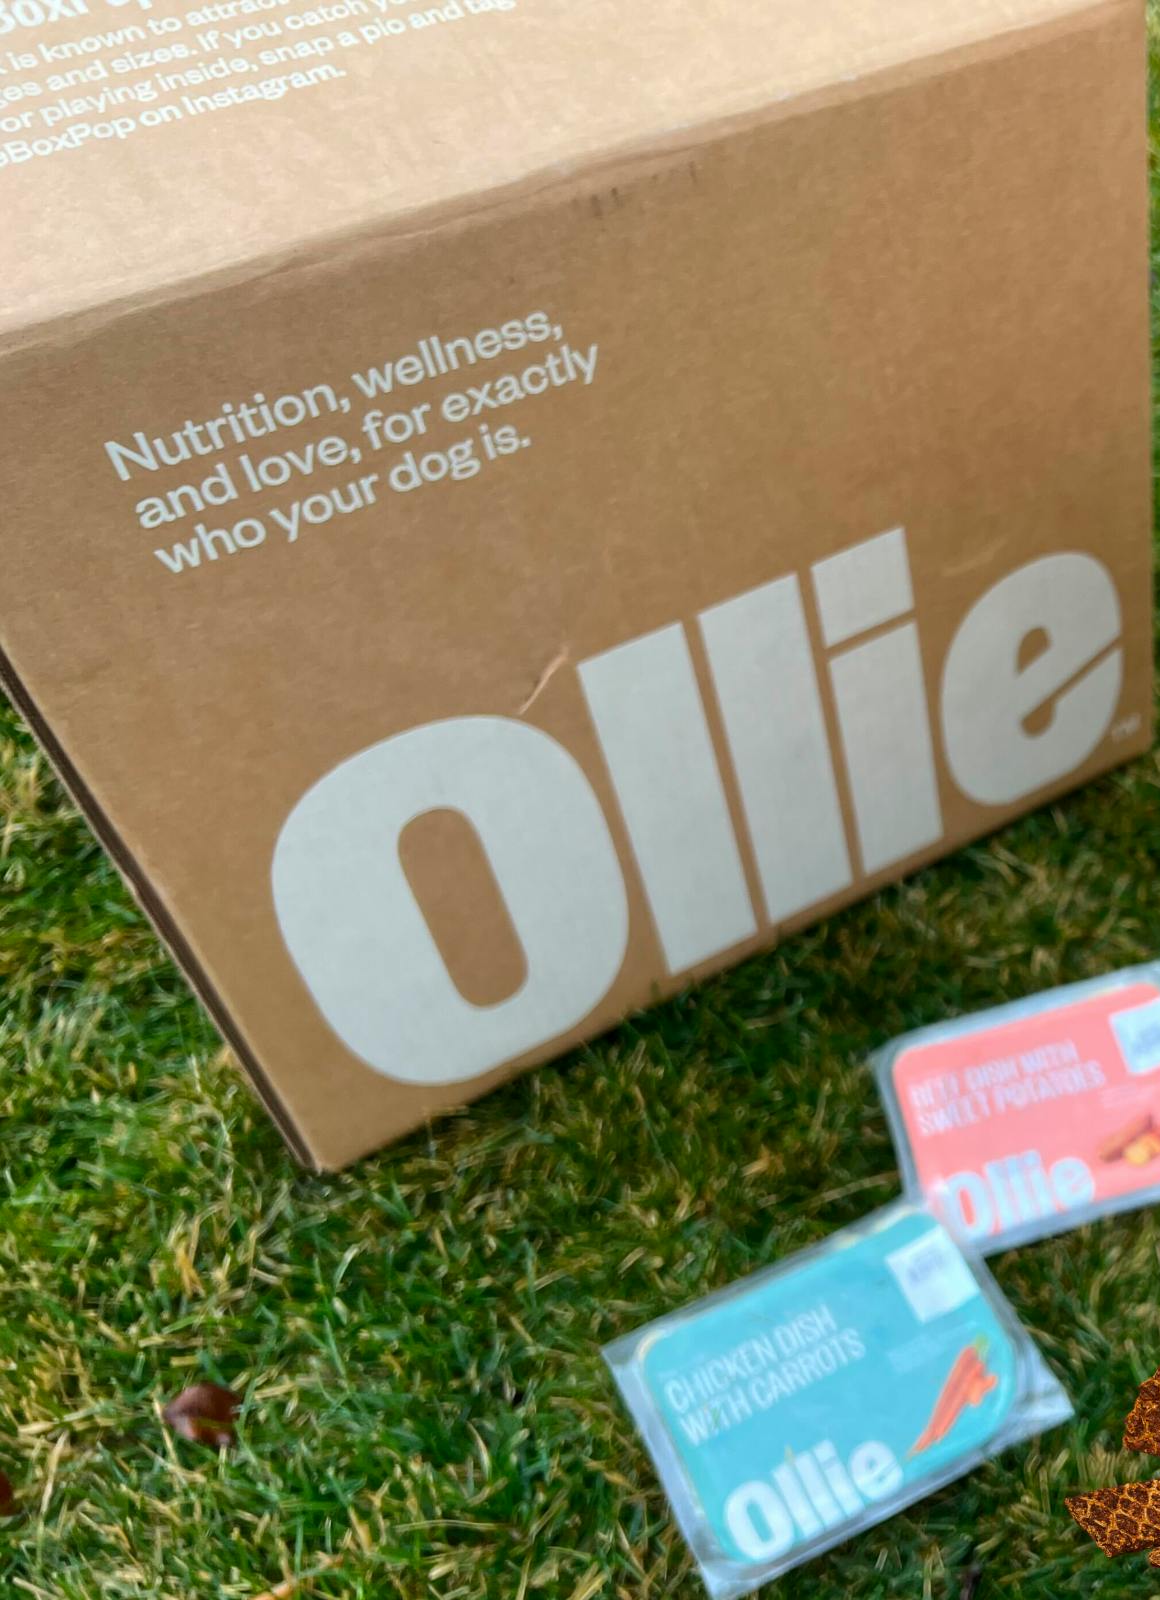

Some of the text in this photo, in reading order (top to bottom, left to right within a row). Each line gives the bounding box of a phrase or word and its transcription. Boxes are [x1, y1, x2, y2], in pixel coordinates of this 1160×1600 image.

[0, 111, 34, 133] or
[40, 79, 158, 127] playing
[155, 57, 259, 92] inside,
[258, 36, 334, 66] snap
[337, 31, 360, 49] a
[408, 2, 466, 30] and
[5, 50, 39, 71] is
[38, 24, 147, 63] known
[147, 16, 183, 36] to
[46, 59, 109, 91] and
[110, 42, 198, 74] sizes.
[195, 29, 221, 53] If
[221, 20, 282, 51] you
[140, 103, 183, 127] on
[182, 63, 347, 116] Instagram.
[104, 310, 563, 481] Nutrition, wellness,
[135, 343, 599, 529] and love, for exactly
[154, 423, 532, 573] who your dog is.
[271, 526, 1123, 1086] Ollie
[947, 1149, 1095, 1238] Ollie
[664, 1333, 778, 1413] CHICKEN
[773, 1303, 837, 1356] DISH
[751, 1327, 867, 1410] CARROTS
[724, 1438, 904, 1562] Ollie
